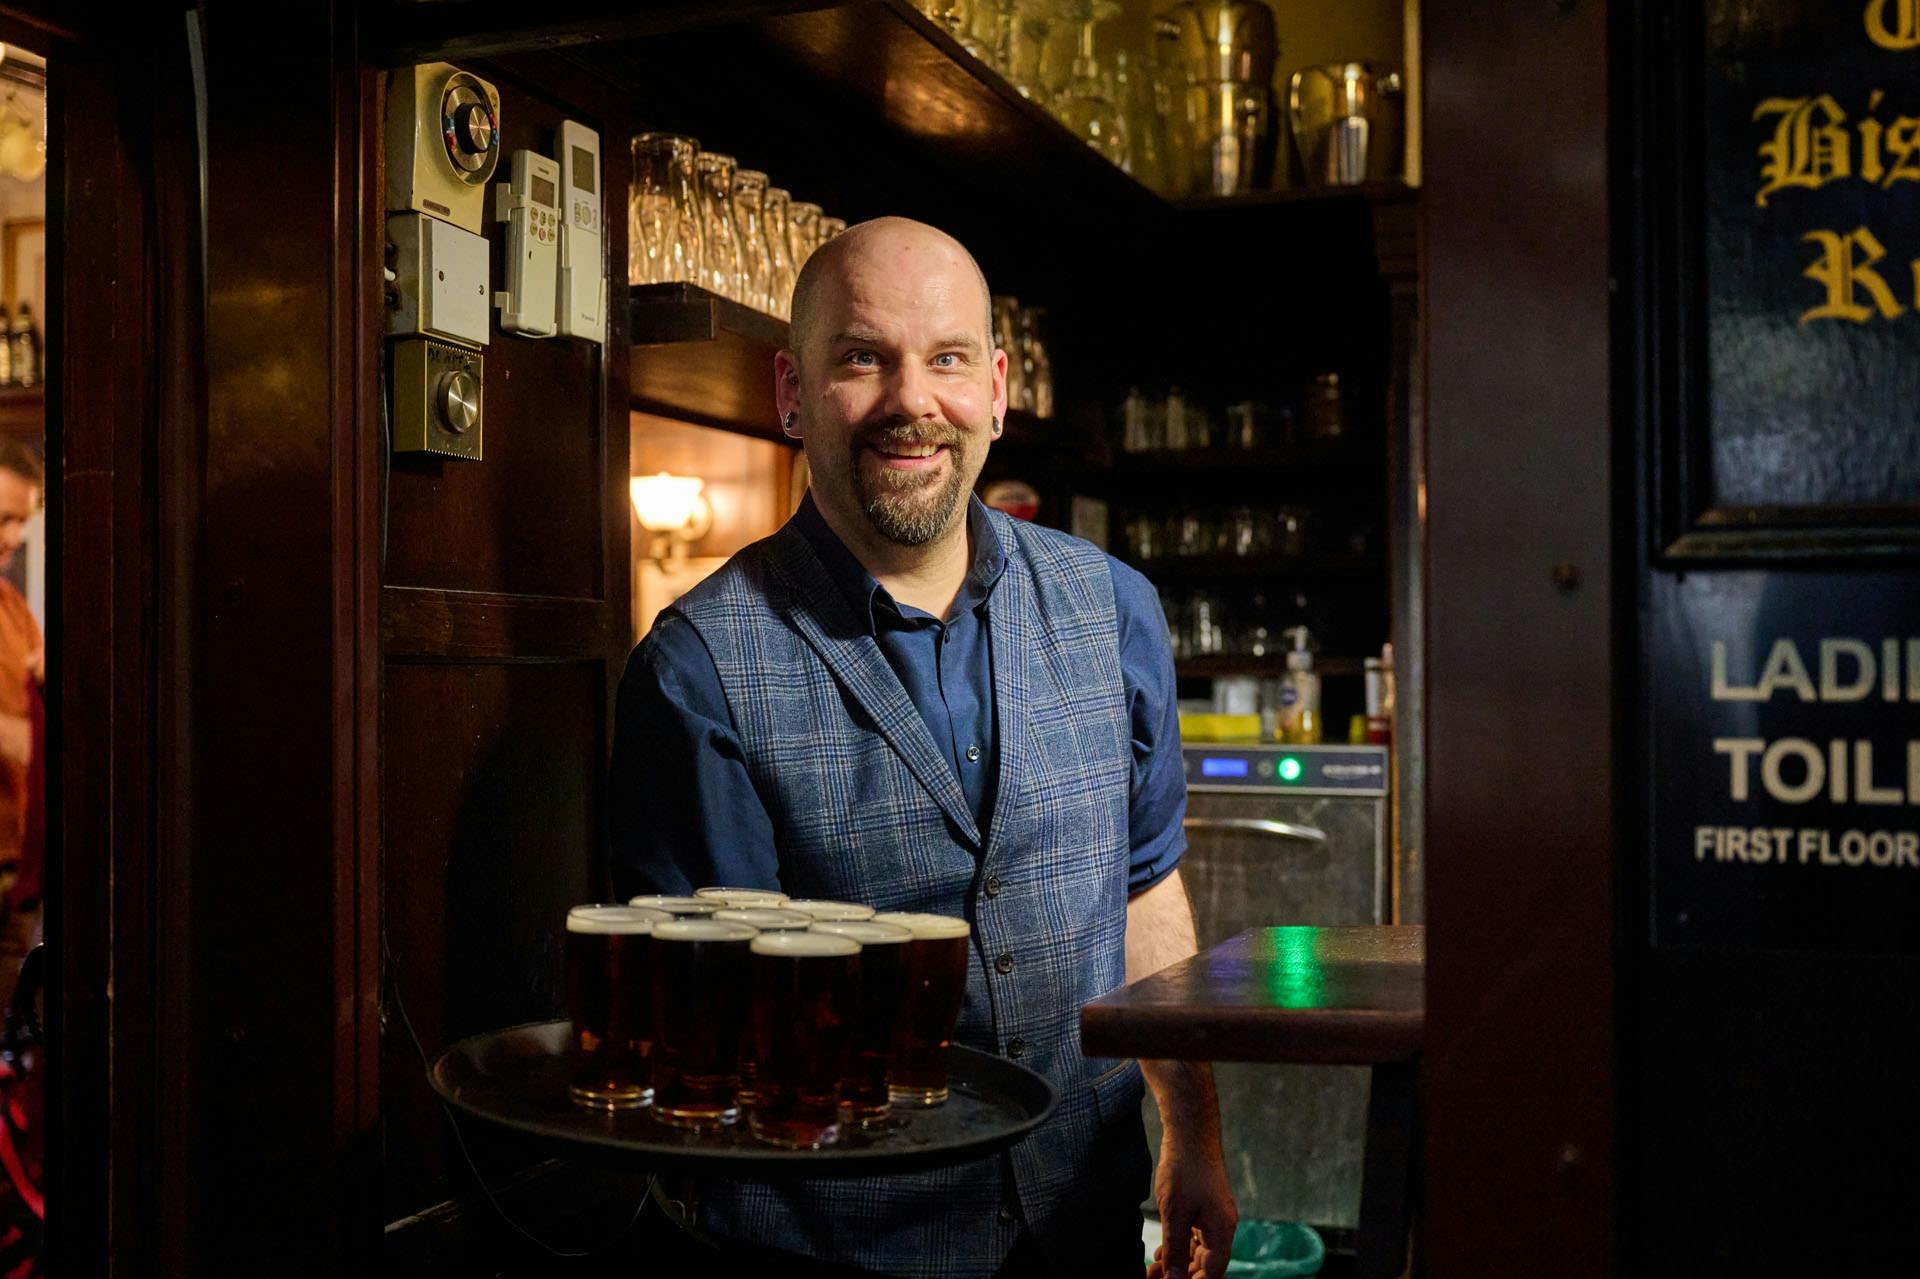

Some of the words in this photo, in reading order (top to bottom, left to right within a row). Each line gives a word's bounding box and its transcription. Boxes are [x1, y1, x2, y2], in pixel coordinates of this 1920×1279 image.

[1800, 226, 1920, 325] R
[1711, 638, 1920, 702] LADI
[1713, 737, 1920, 804] TOIL
[1695, 826, 1793, 864] FIRST
[1798, 828, 1920, 868] FLOOR
